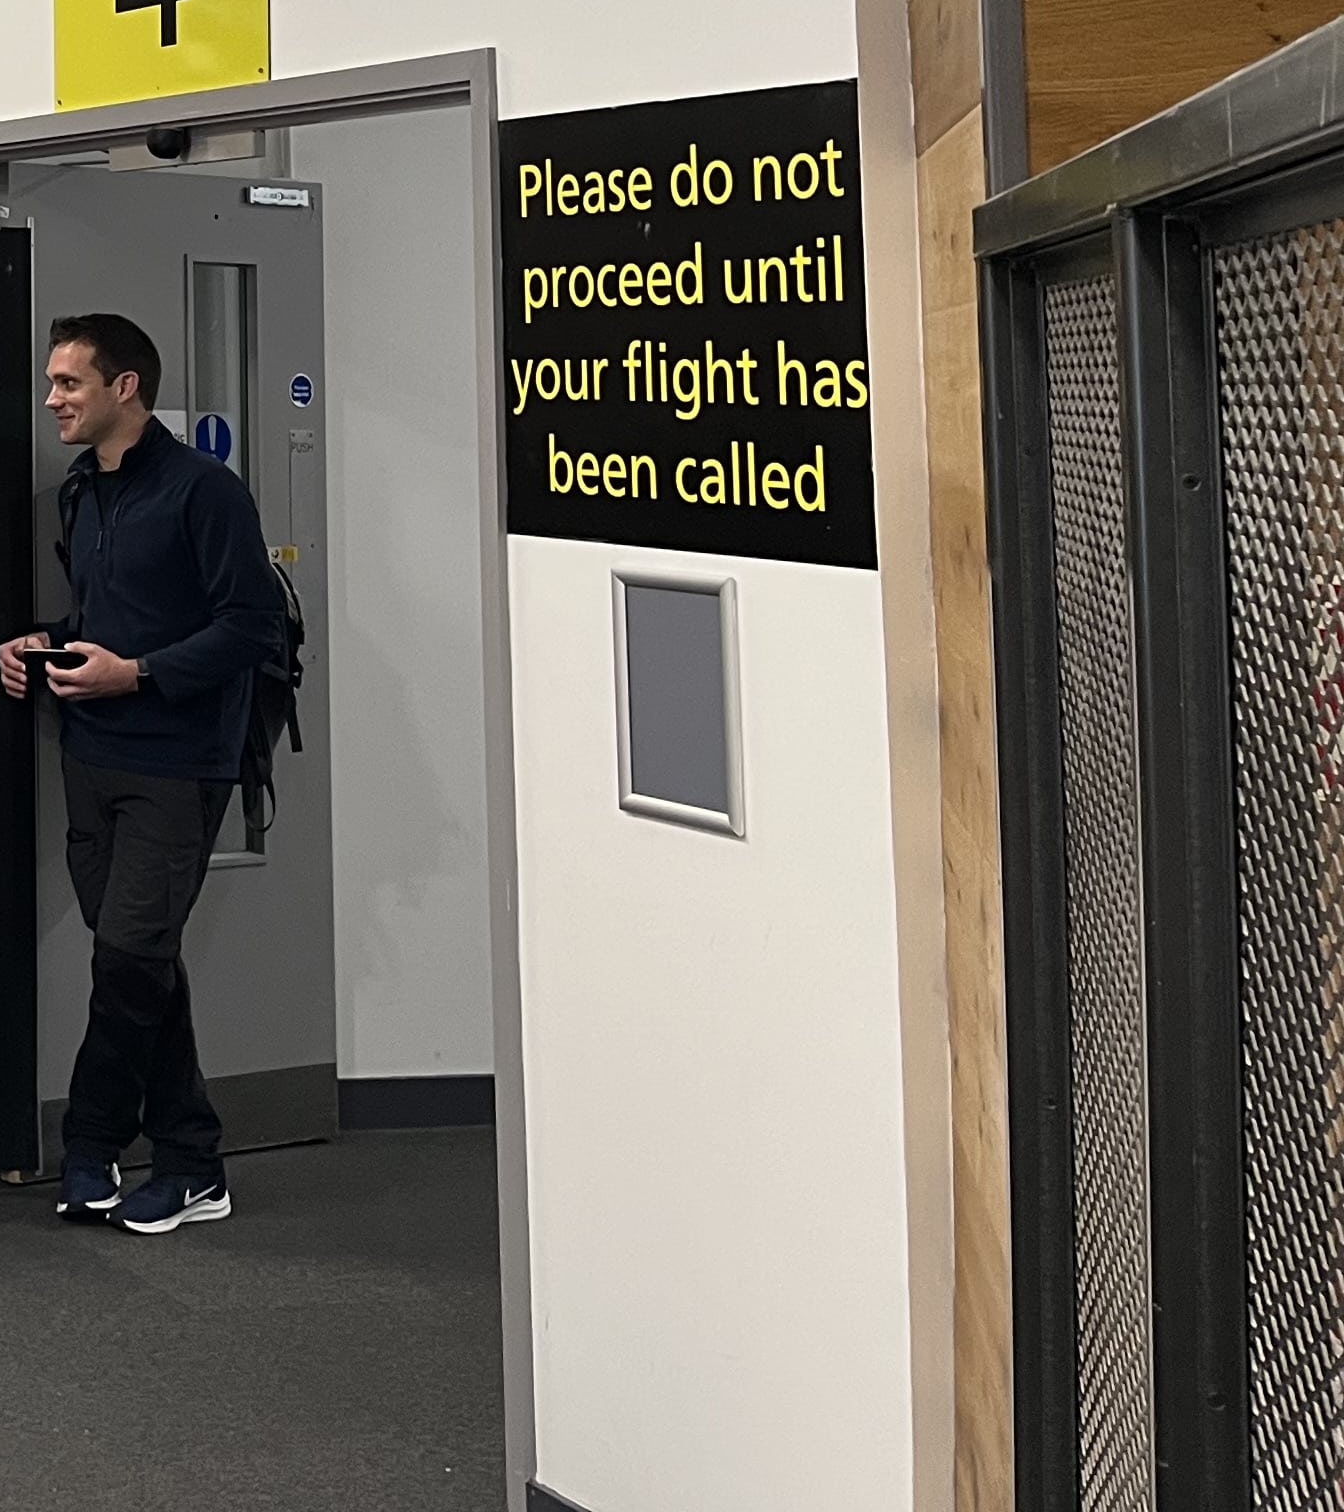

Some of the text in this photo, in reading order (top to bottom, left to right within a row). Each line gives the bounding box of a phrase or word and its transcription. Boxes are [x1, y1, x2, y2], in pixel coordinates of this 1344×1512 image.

[519, 139, 845, 218] Please do not
[523, 234, 844, 324] proceed until
[511, 339, 869, 421] your flight has
[548, 433, 826, 512] been called
